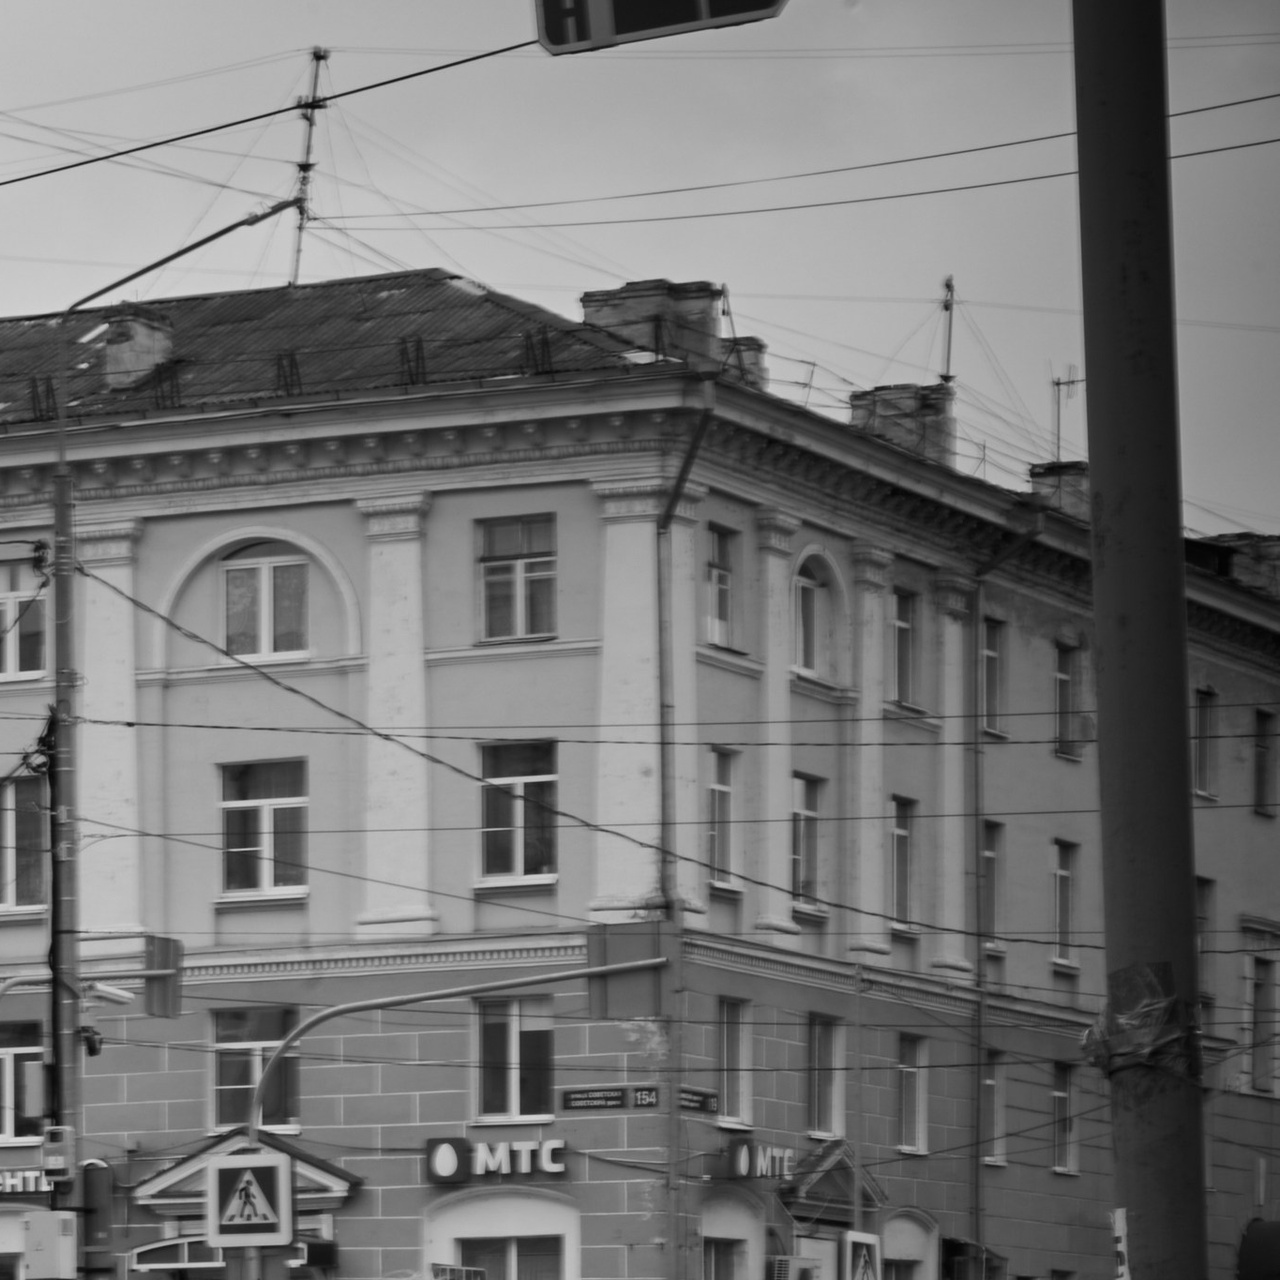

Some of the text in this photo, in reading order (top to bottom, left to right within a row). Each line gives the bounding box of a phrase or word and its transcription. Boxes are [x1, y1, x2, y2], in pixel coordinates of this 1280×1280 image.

[635, 1090, 657, 1105] 154
[475, 1139, 566, 1175] МТС
[756, 1145, 795, 1181] МТС
